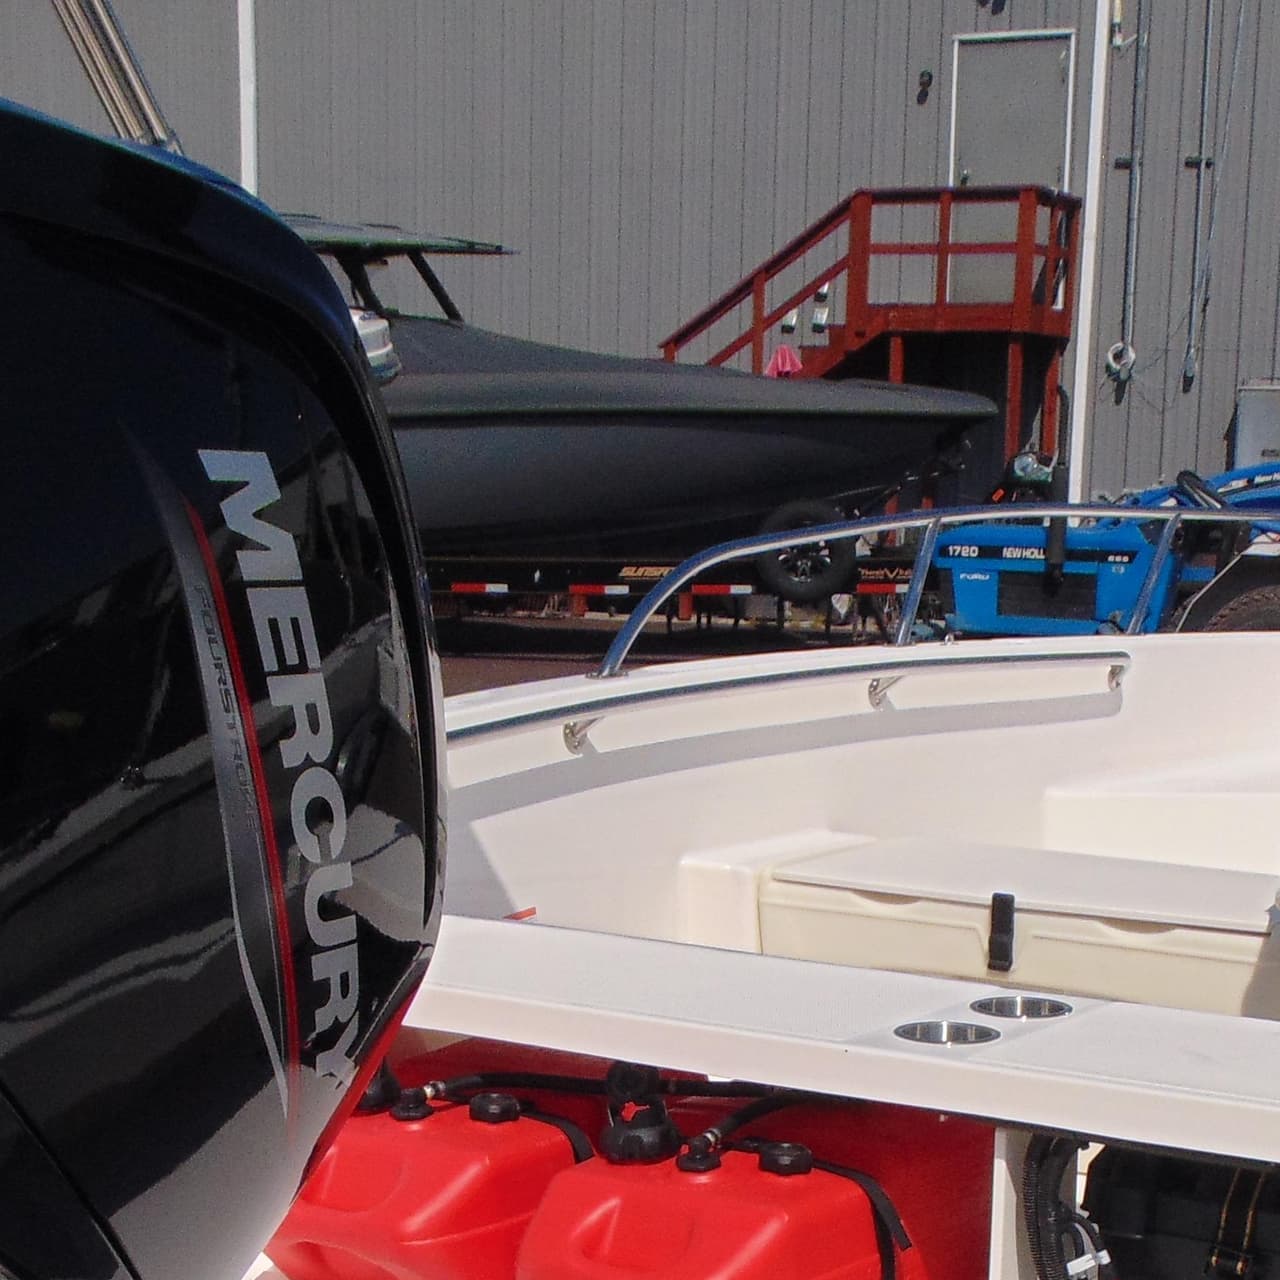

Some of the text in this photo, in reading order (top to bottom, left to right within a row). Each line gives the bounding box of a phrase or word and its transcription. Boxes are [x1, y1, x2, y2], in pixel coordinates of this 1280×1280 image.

[948, 546, 979, 557] 1720
[1022, 548, 1047, 560] HOLL
[197, 448, 360, 1090] MERCURY
